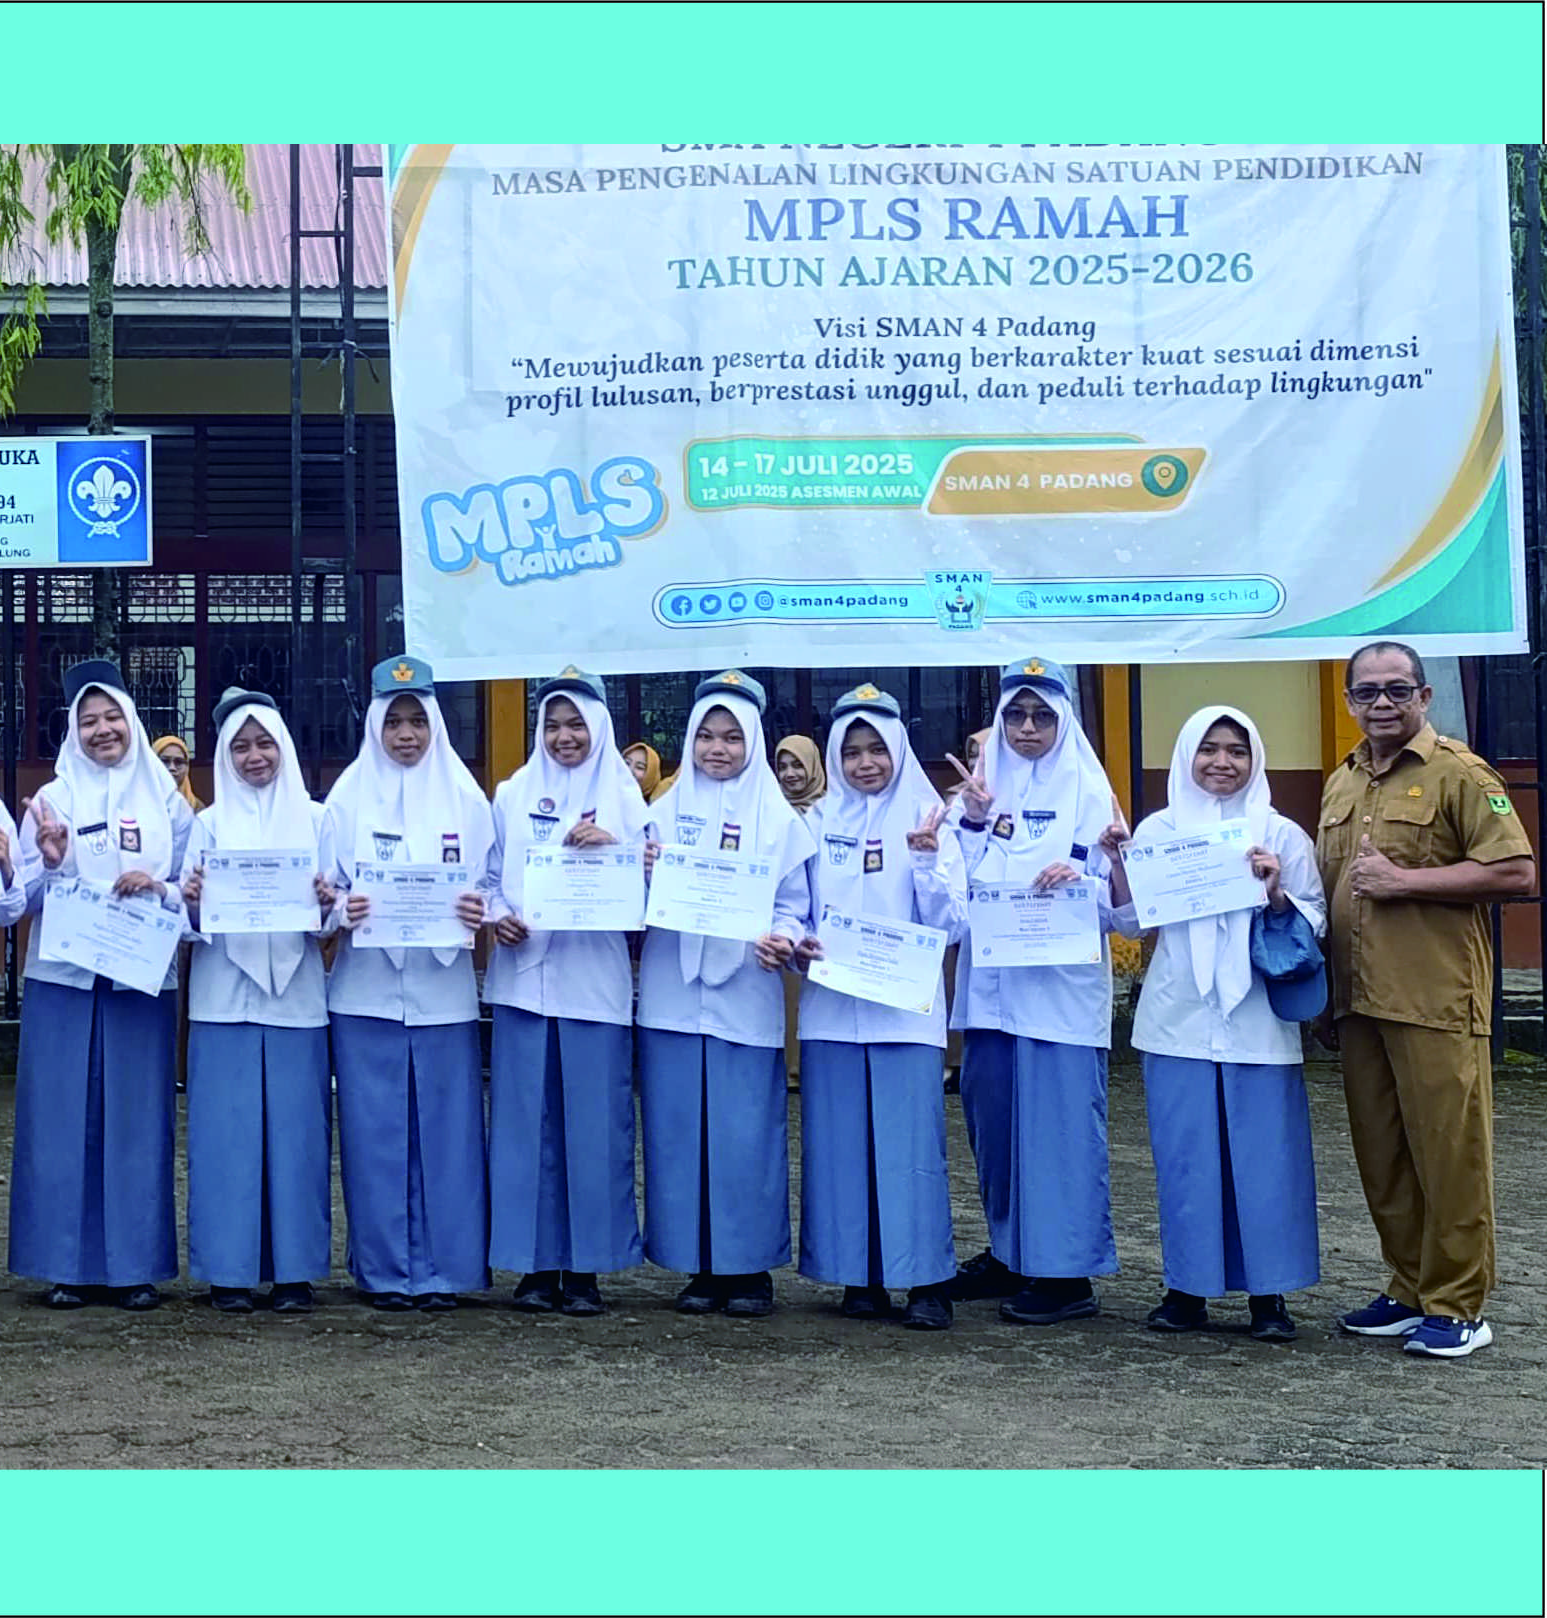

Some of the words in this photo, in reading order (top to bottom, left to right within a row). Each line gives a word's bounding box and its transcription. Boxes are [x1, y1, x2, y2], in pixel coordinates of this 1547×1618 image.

[492, 171, 587, 196] MASA
[596, 163, 817, 192] PENGENALAN
[828, 160, 1056, 186] LINGKUNGAN
[1067, 159, 1201, 183] SATUAN
[1213, 152, 1424, 181] PENDIDIKAN
[744, 198, 923, 242] MPLS
[944, 195, 1190, 240] RAMAH
[668, 257, 825, 290] TAHUN
[839, 255, 1014, 287] AJARAN
[1028, 252, 1254, 286] 2025-2026
[814, 317, 867, 338] Visi
[876, 316, 964, 338] SMAN
[972, 318, 988, 337] 4
[996, 316, 1096, 342] Padang
[511, 353, 704, 384] “Mewujudkan
[713, 352, 805, 377] peserta
[815, 347, 885, 370] didik
[893, 350, 961, 377] yang
[971, 347, 1134, 369] berkarakter
[1142, 344, 1205, 367] kuat
[1213, 341, 1303, 365] sesuai
[1310, 336, 1420, 363] dimensi
[506, 389, 583, 417] profil
[591, 385, 701, 410] lulusan,
[710, 378, 856, 407] berprestasi
[865, 378, 969, 406] unggul,
[977, 377, 1028, 400] dan
[1038, 374, 1125, 405] peduli
[1134, 370, 1262, 400] terhadap
[1270, 368, 1433, 396] lingkungan"
[698, 456, 727, 478] 14
[755, 454, 775, 475] 17
[780, 454, 839, 477] JULI
[844, 453, 914, 475] 2025
[701, 487, 718, 501] 12
[721, 486, 752, 500] JULI
[754, 484, 788, 499] 2025
[790, 484, 869, 500] ASESMEN
[871, 484, 922, 499] AWAL
[944, 474, 1011, 491] SMAN
[1016, 473, 1030, 489] 4
[1040, 472, 1133, 490] PADANG
[428, 459, 656, 561] MPLS
[502, 535, 618, 582] Ramah
[934, 573, 983, 583] SMAN
[955, 584, 962, 592] 4
[777, 594, 909, 609] @sman4padang
[1040, 589, 1260, 605] www.sman4padang.sch.id
